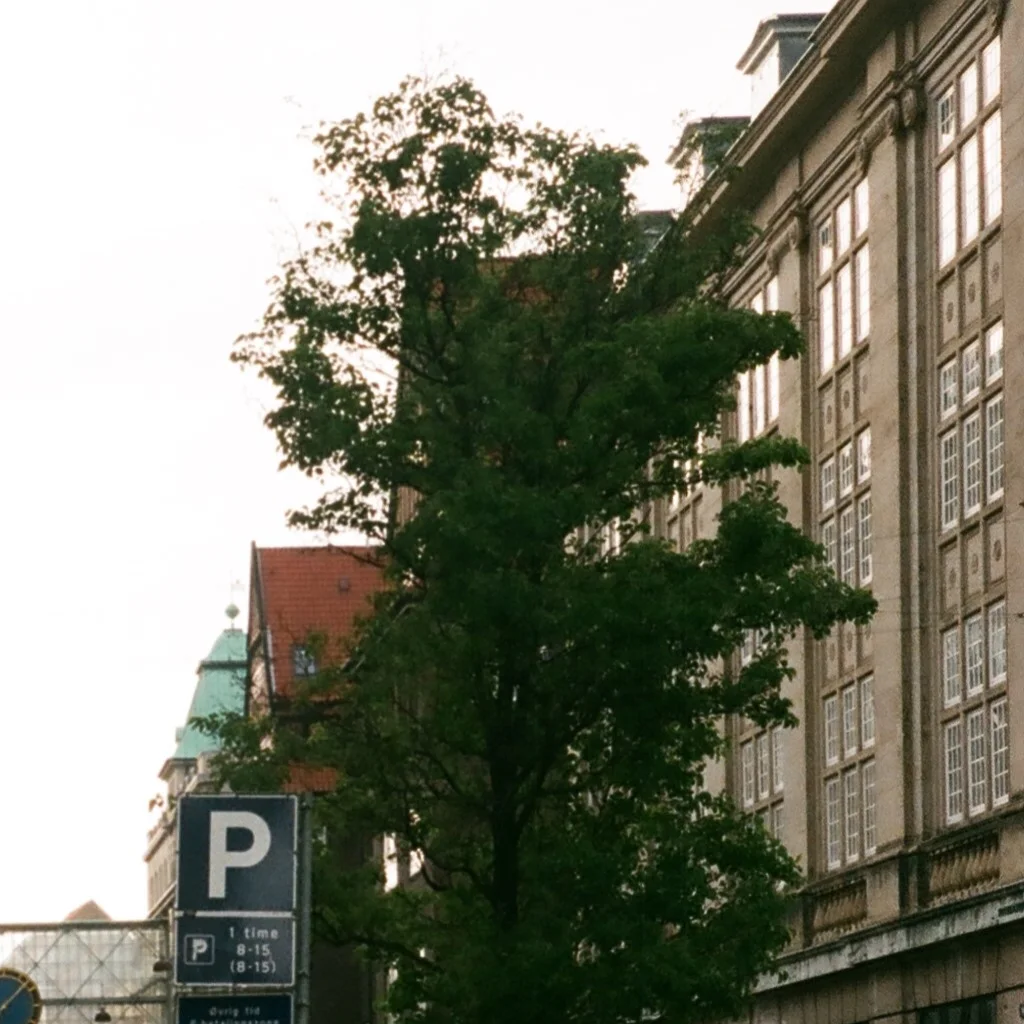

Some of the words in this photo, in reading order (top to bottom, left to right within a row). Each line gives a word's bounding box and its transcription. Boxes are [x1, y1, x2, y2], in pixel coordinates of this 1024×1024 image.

[208, 811, 270, 898] P
[229, 927, 235, 938] 1
[244, 927, 279, 939] time
[192, 939, 208, 960] P
[236, 944, 271, 956] 8-15
[230, 961, 277, 973] (8-15)
